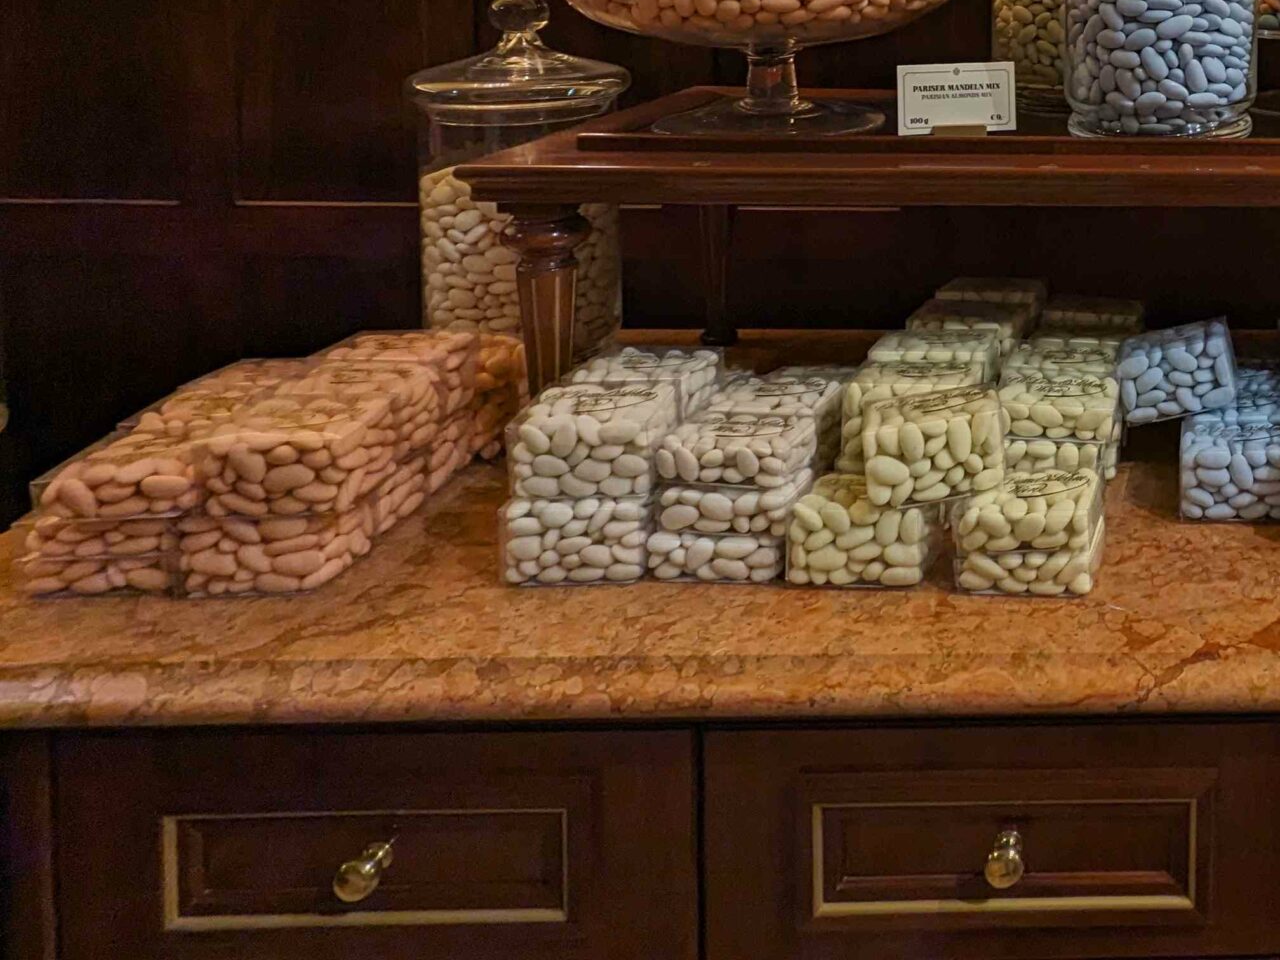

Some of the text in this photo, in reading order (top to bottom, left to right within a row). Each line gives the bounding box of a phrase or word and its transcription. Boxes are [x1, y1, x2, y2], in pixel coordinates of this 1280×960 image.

[912, 82, 1001, 93] PARISER MANDELN MIX
